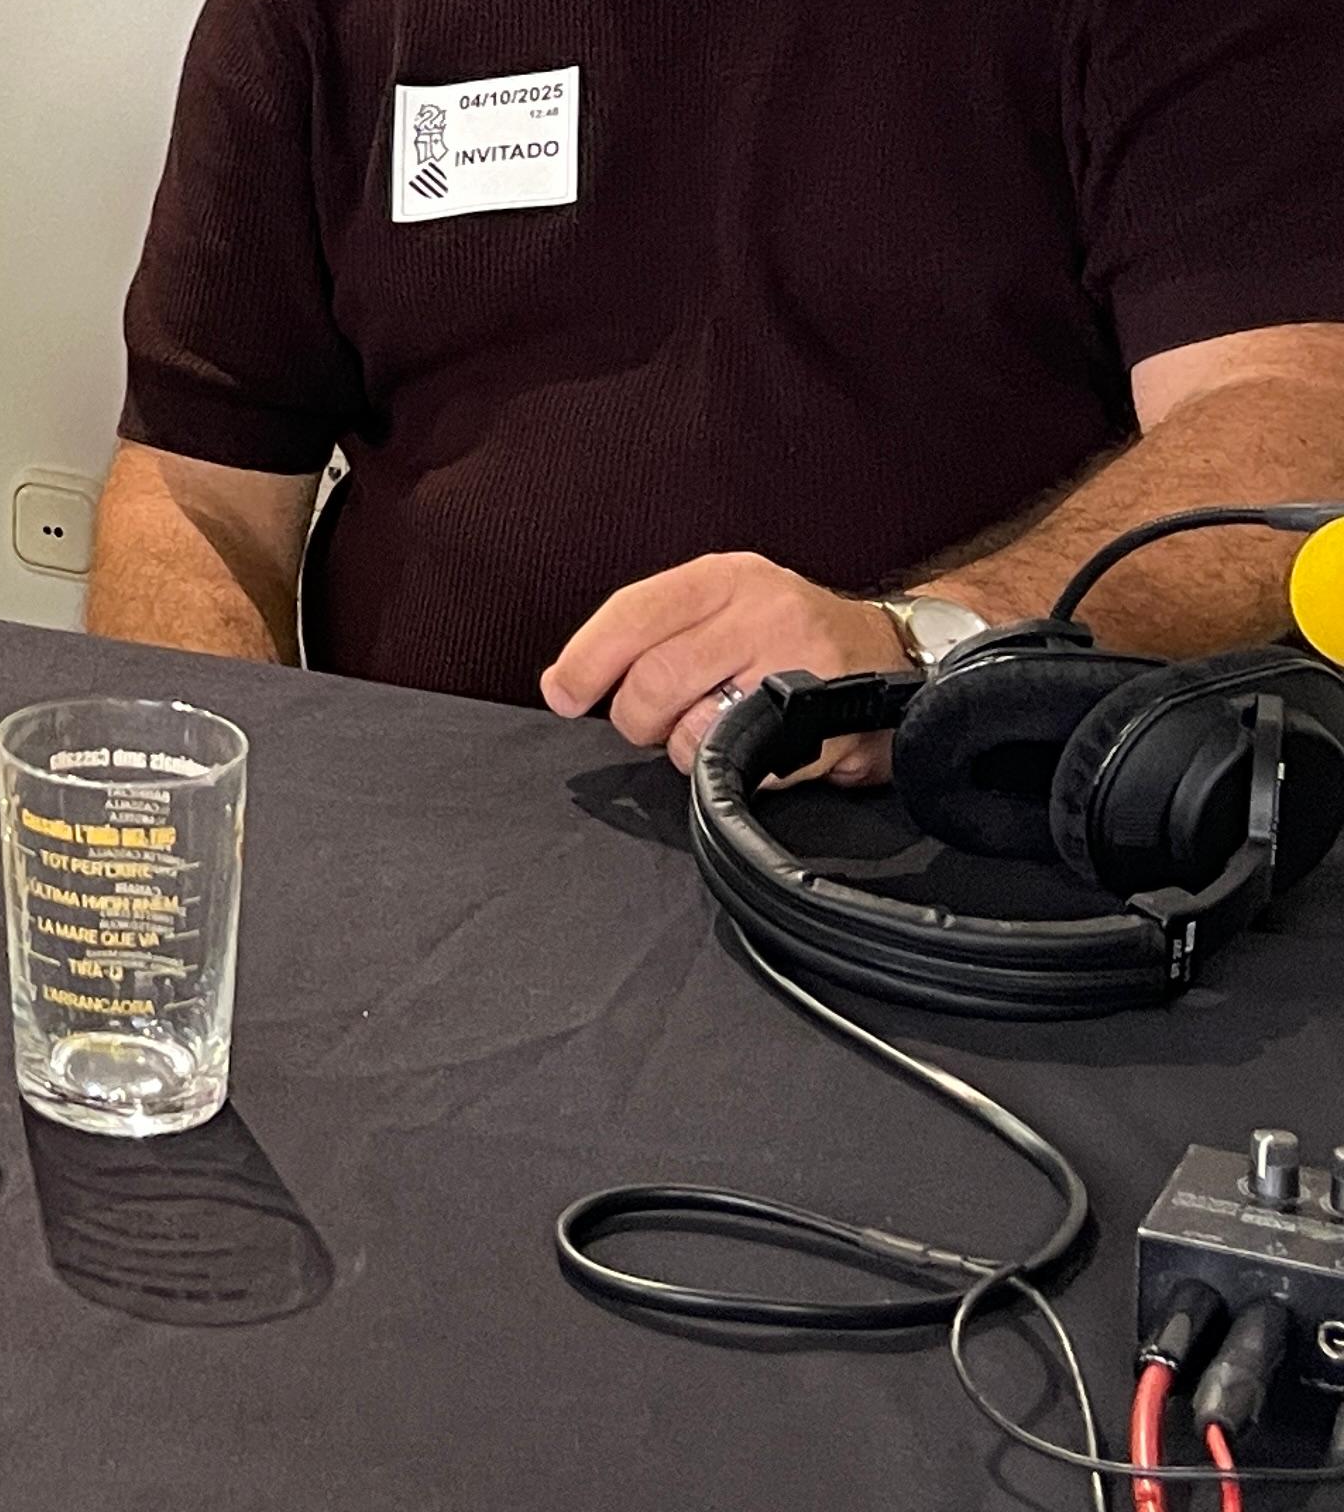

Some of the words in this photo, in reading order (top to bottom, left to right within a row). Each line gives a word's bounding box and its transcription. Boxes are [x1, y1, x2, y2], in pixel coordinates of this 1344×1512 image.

[459, 83, 564, 110] 04/10/2025
[454, 140, 560, 167] INVITADO
[40, 849, 69, 872] TOT
[37, 916, 55, 935] LA
[56, 920, 99, 945] MARE
[101, 931, 137, 948] QUE
[139, 932, 160, 948] VA
